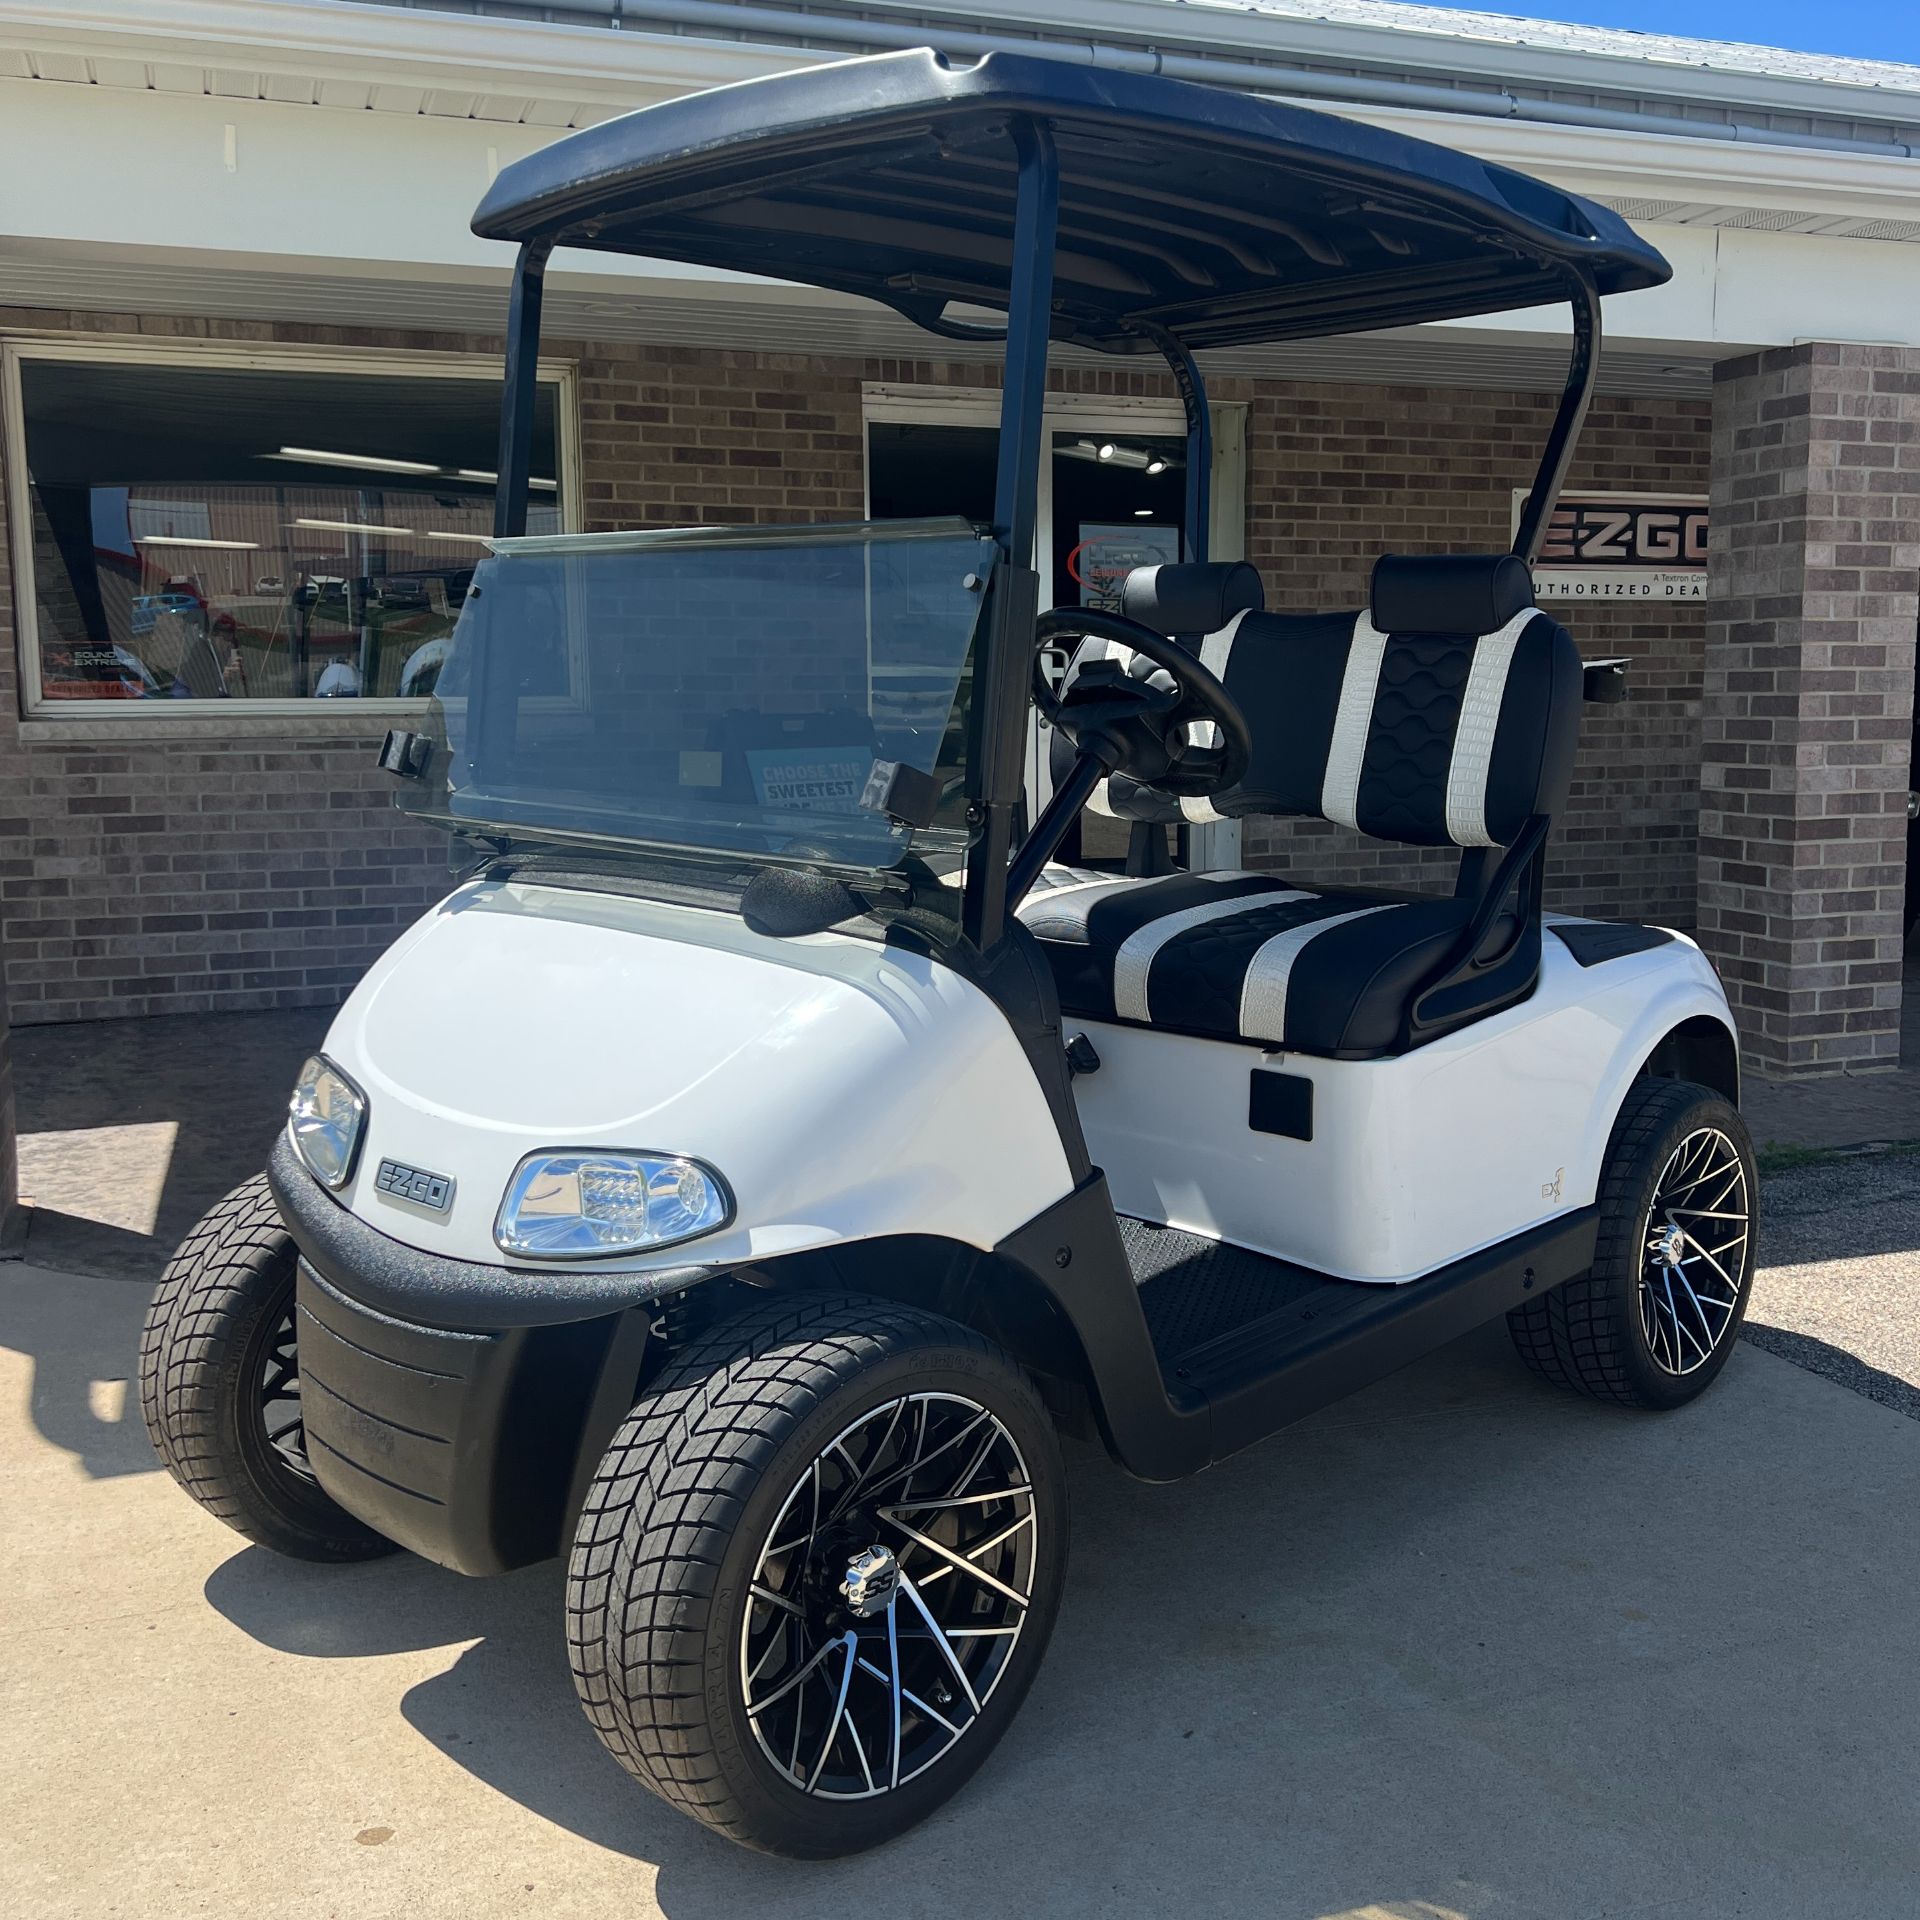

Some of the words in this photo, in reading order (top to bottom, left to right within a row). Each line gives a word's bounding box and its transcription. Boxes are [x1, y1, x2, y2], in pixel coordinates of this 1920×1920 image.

[1654, 574, 1659, 582] A
[1662, 574, 1688, 582] Textron
[1691, 574, 1709, 583] Com
[1534, 583, 1650, 596] UTHORIZED
[1665, 585, 1709, 597] DEA
[74, 651, 117, 659] SOUND
[762, 765, 828, 781] CHOOSE
[829, 762, 862, 778] THE
[767, 781, 854, 799] SWEETEST
[376, 1162, 449, 1208] EZGO
